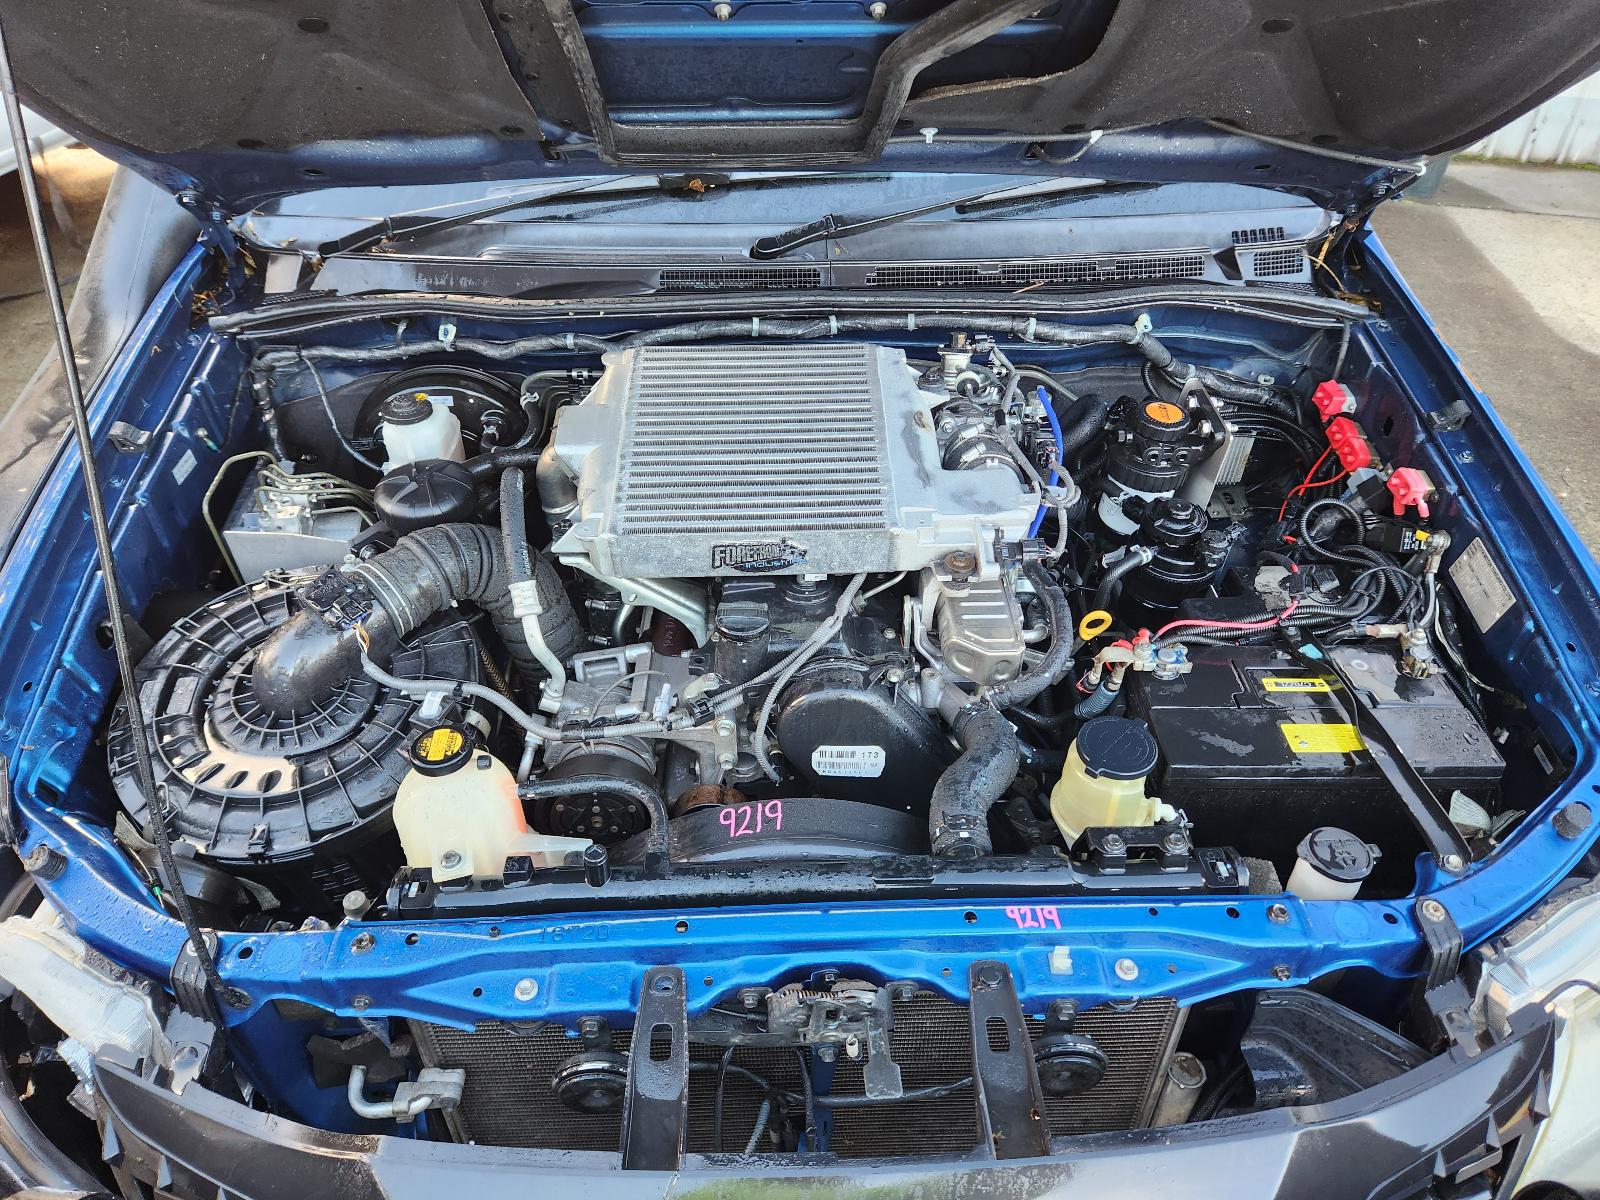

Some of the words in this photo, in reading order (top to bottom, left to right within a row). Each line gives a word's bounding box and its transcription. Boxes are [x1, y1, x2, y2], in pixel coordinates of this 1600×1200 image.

[861, 751, 879, 759] 173
[719, 799, 783, 838] 9219
[1005, 905, 1062, 930] 9219
